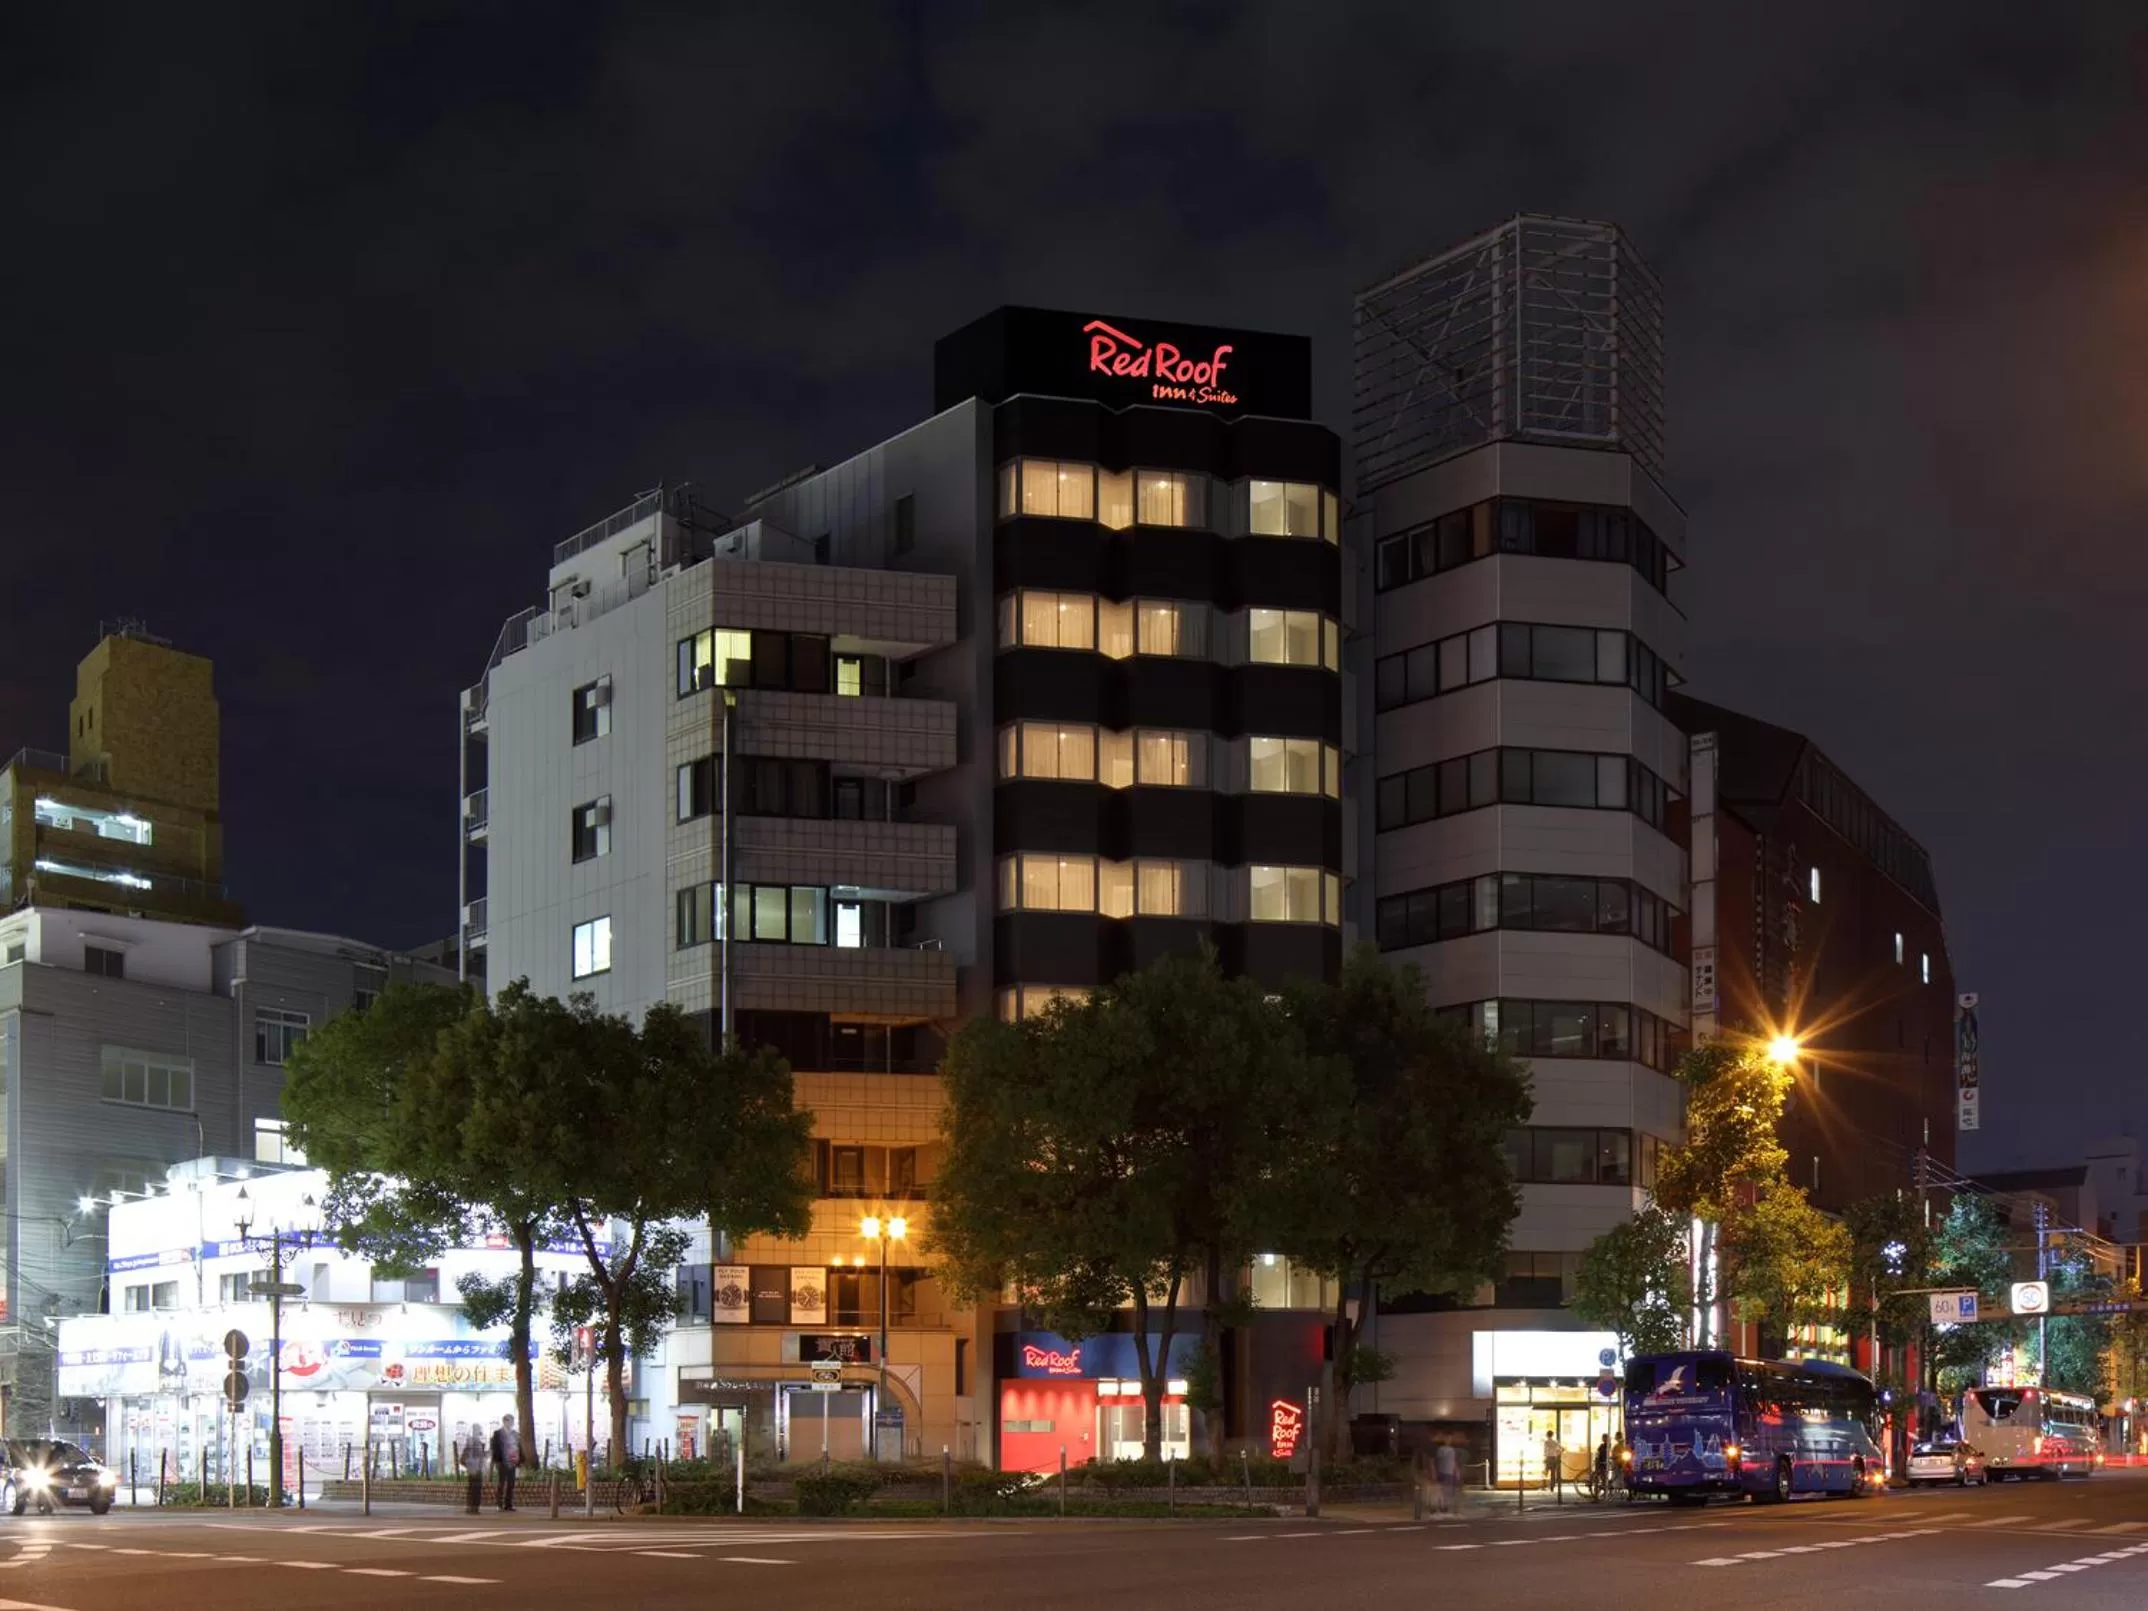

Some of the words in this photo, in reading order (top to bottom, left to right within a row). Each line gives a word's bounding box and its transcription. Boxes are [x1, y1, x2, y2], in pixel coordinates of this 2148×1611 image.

[1090, 334, 1152, 377] Red
[1155, 342, 1233, 388] Roof
[1197, 386, 1238, 404] Suites
[1026, 1350, 1048, 1367] Red
[1049, 1350, 1080, 1367] Roof
[1274, 1410, 1296, 1425] Red
[1272, 1423, 1301, 1442] Roof
